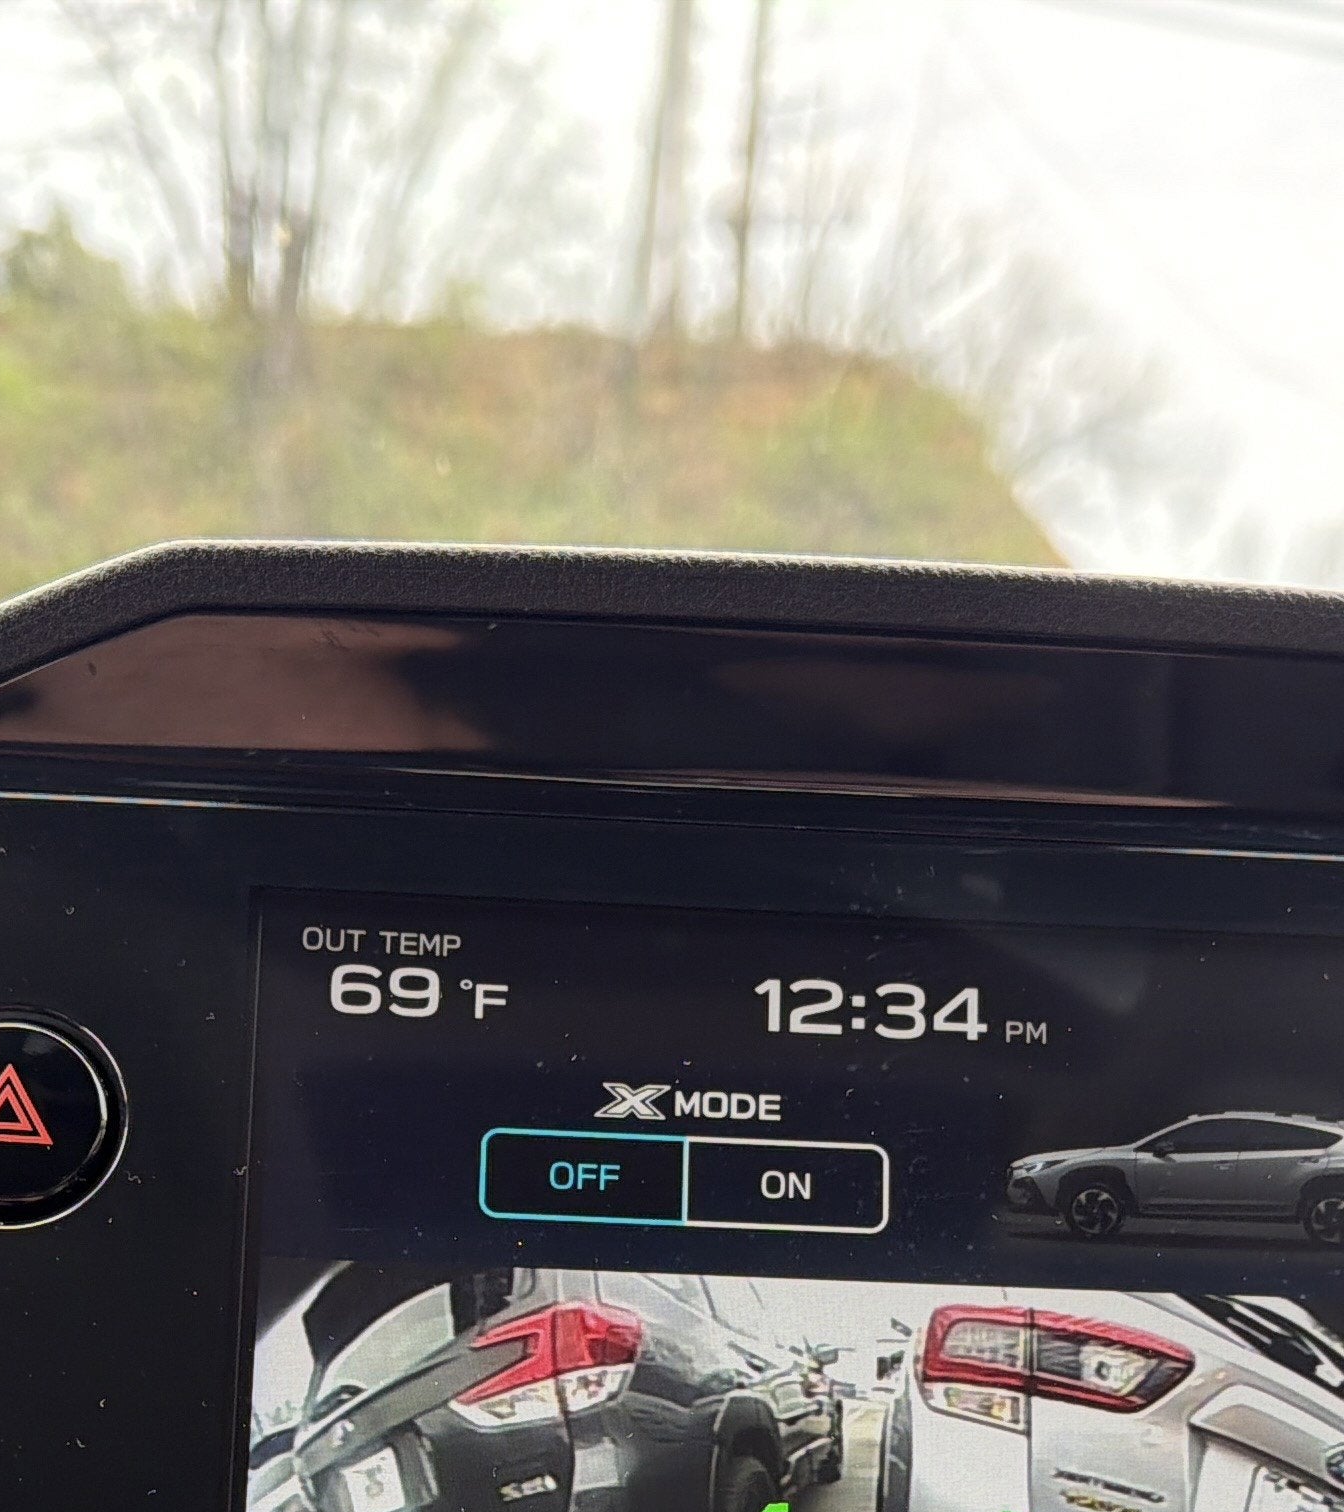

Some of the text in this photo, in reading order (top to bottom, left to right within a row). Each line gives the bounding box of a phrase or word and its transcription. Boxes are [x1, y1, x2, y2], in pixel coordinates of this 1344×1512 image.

[301, 926, 463, 958] OUT TEMP
[328, 964, 441, 1019] 69
[754, 977, 1049, 1045] 12:34 PM
[674, 1091, 783, 1122] MODE
[548, 1160, 622, 1192] OFF
[759, 1169, 812, 1201] ON
